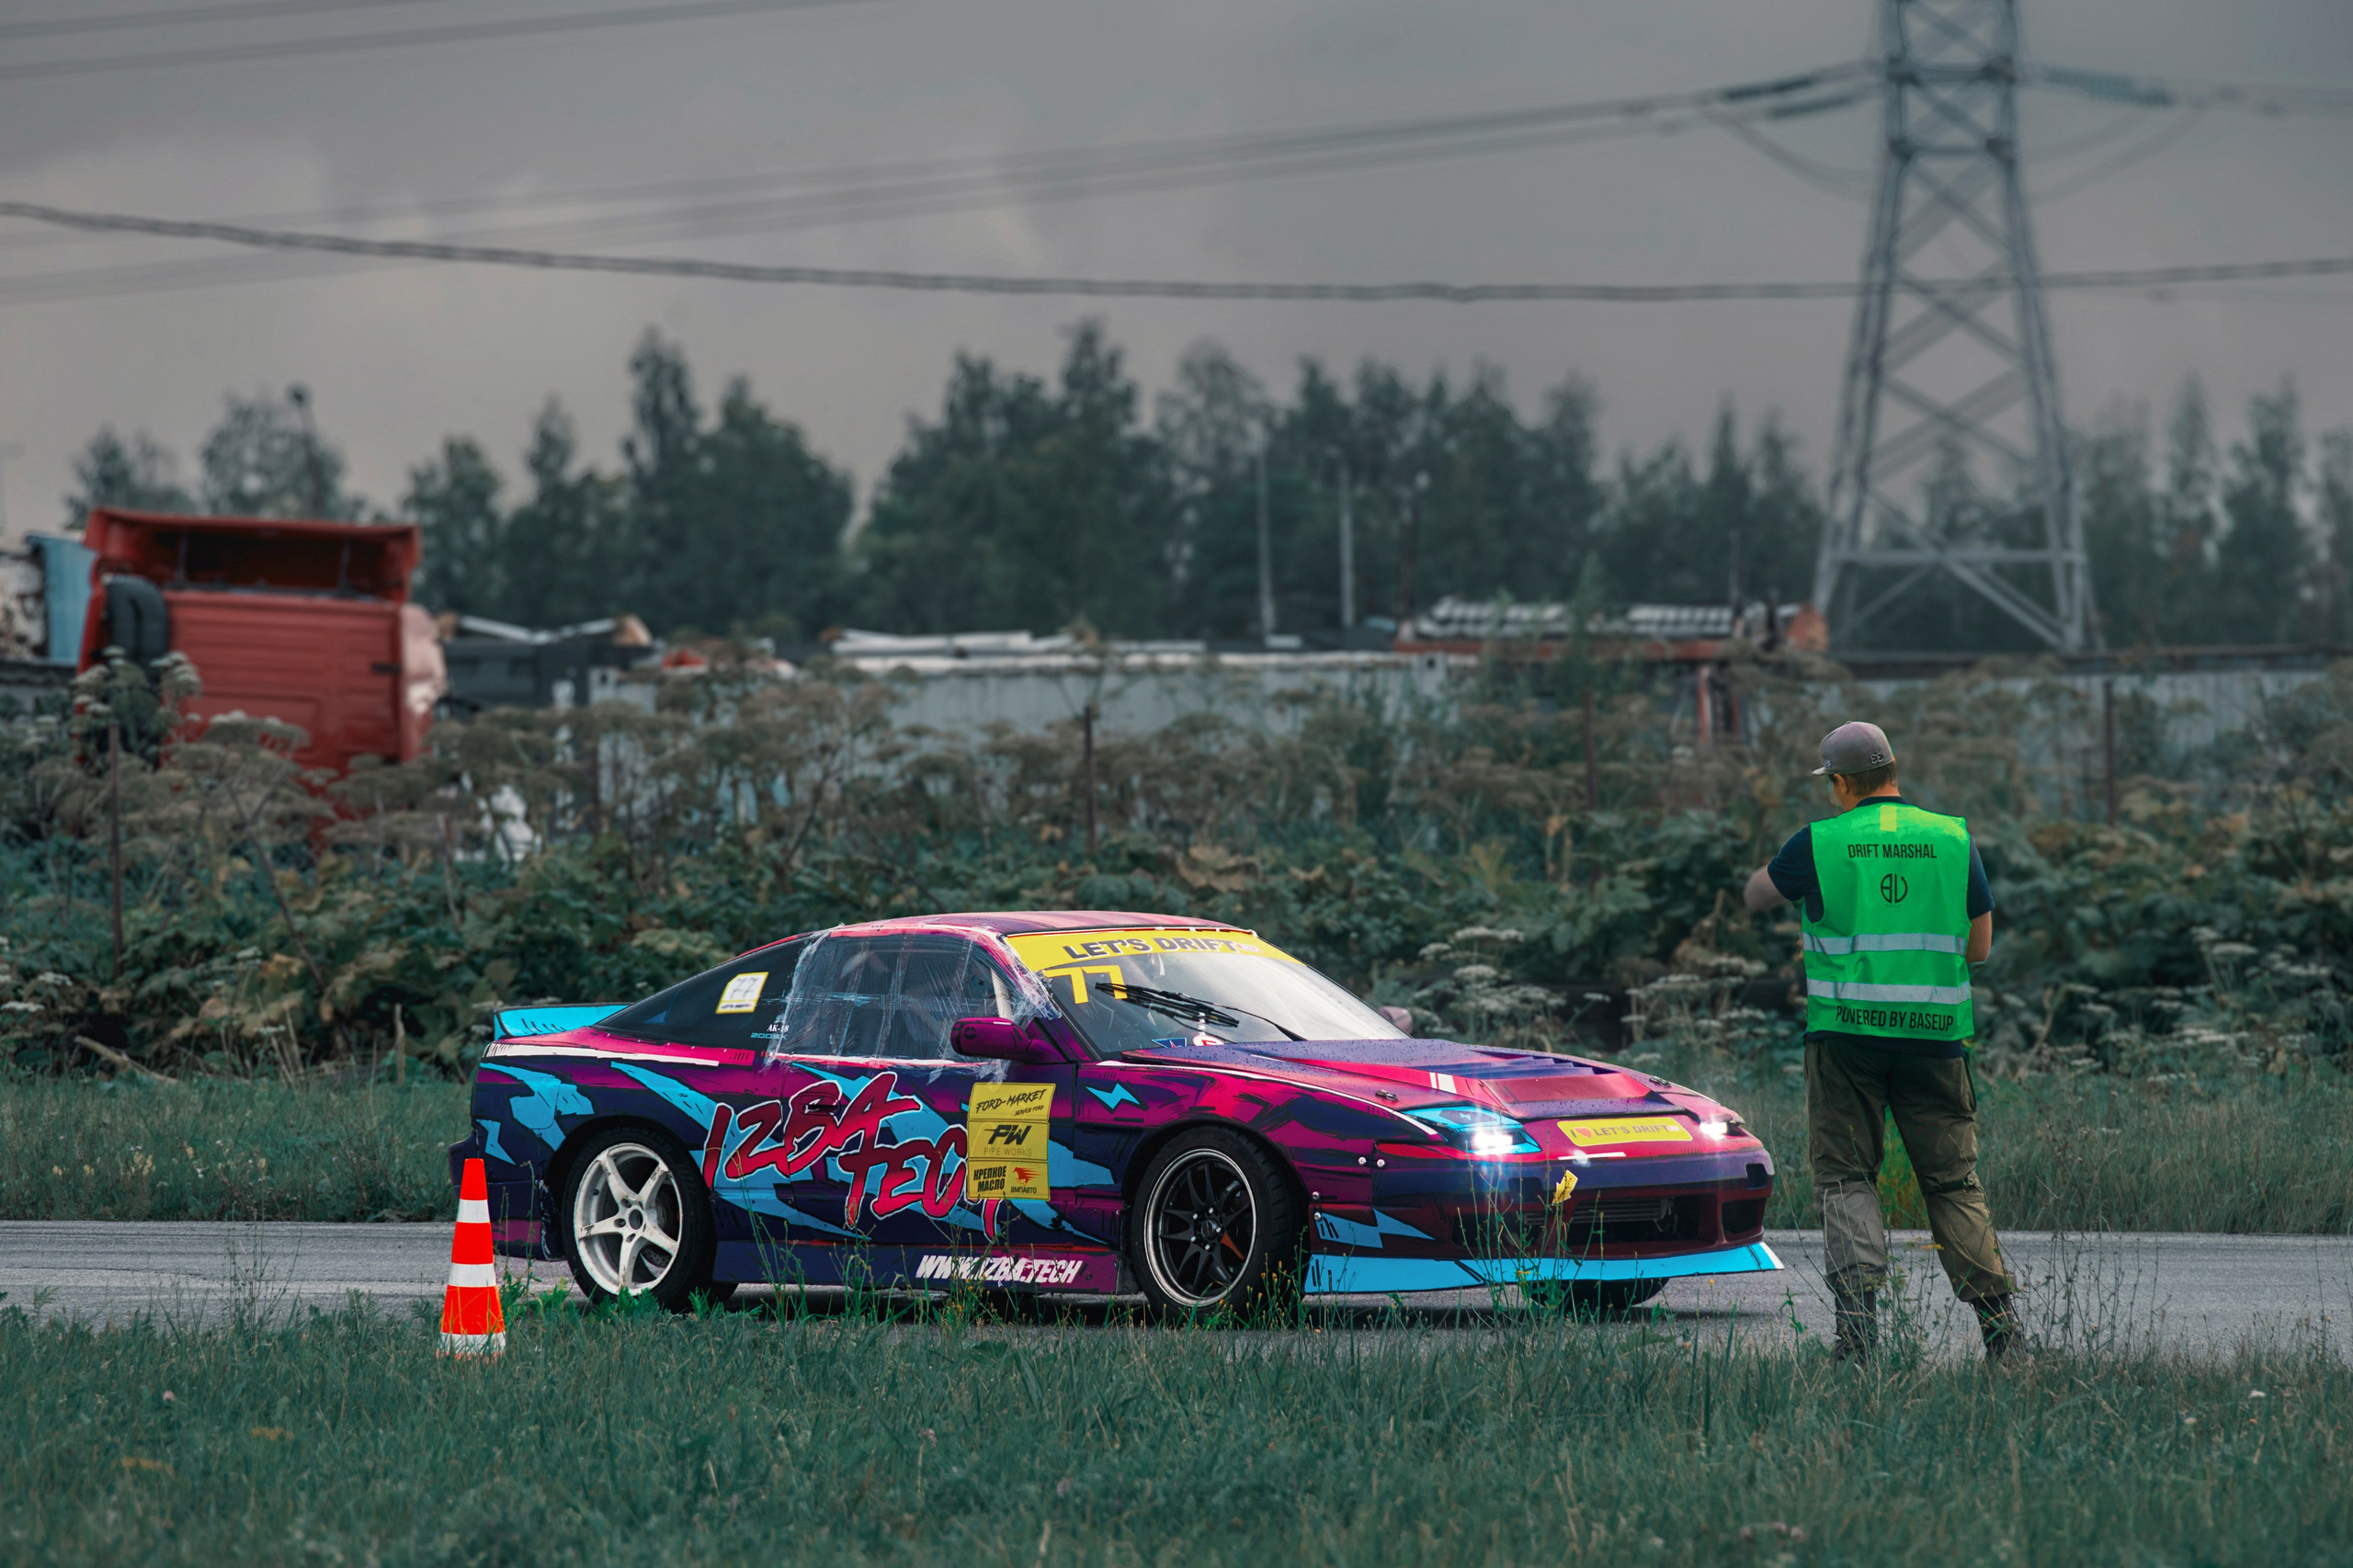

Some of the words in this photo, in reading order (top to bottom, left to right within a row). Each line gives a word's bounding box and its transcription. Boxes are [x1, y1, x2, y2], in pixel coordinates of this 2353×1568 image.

[1847, 844, 1880, 858] DRIFT
[1882, 844, 1938, 858] MARSHAL
[1063, 937, 1151, 960] LET'S
[1154, 937, 1240, 954] DRIFT
[1045, 965, 1127, 1005] 77
[1836, 1006, 1887, 1027] POWERED
[1889, 1008, 1907, 1028] BY
[1909, 1009, 1954, 1031] BASEUP
[1593, 1125, 1630, 1136] LET'S
[1631, 1124, 1669, 1133] DRIFT
[983, 1147, 1001, 1156] PIPE
[1004, 1148, 1032, 1157] WORKS
[973, 1165, 1007, 1181] КРЕПКОЕ
[977, 1178, 1005, 1193] МАСЛО
[1011, 1186, 1037, 1194] ВМПАВТО
